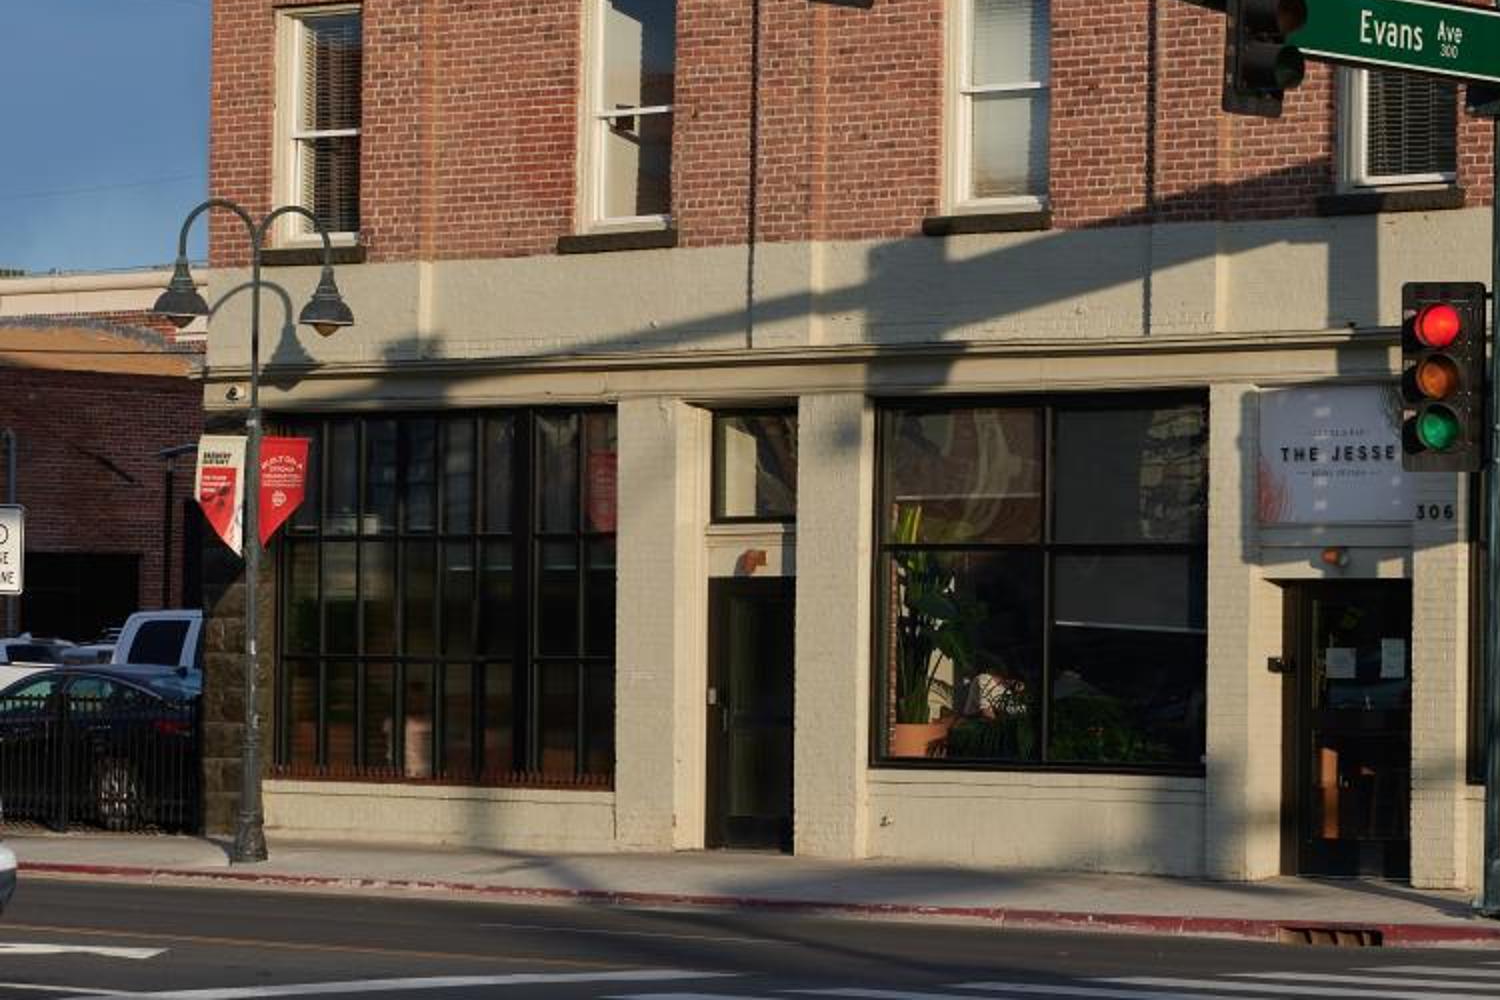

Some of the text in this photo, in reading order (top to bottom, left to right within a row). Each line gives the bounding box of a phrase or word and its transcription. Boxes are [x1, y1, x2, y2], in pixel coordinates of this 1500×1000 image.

[1360, 9, 1463, 51] Evans Ave
[1440, 44, 1459, 59] 300
[1280, 445, 1395, 462] THE JESSE
[1416, 504, 1454, 520] 306
